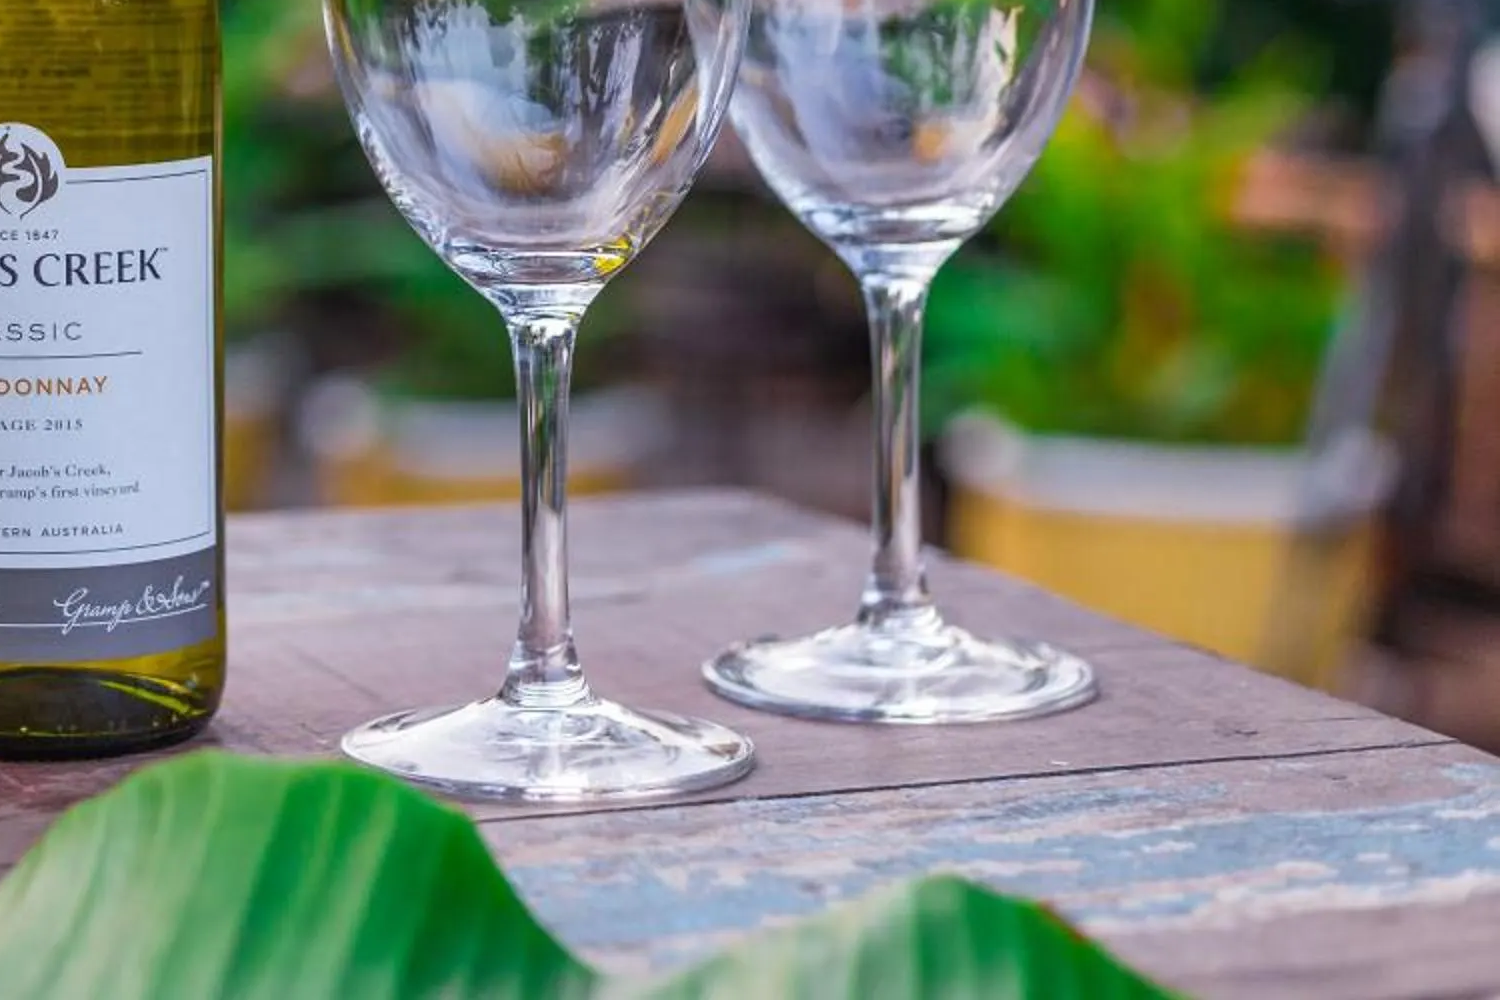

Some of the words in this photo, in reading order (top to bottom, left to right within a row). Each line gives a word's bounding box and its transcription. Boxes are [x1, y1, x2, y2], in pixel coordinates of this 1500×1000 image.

[25, 229, 59, 241] 1847
[7, 465, 61, 478] Jacob's
[51, 485, 79, 498] first
[41, 523, 124, 537] AUSTRALIA
